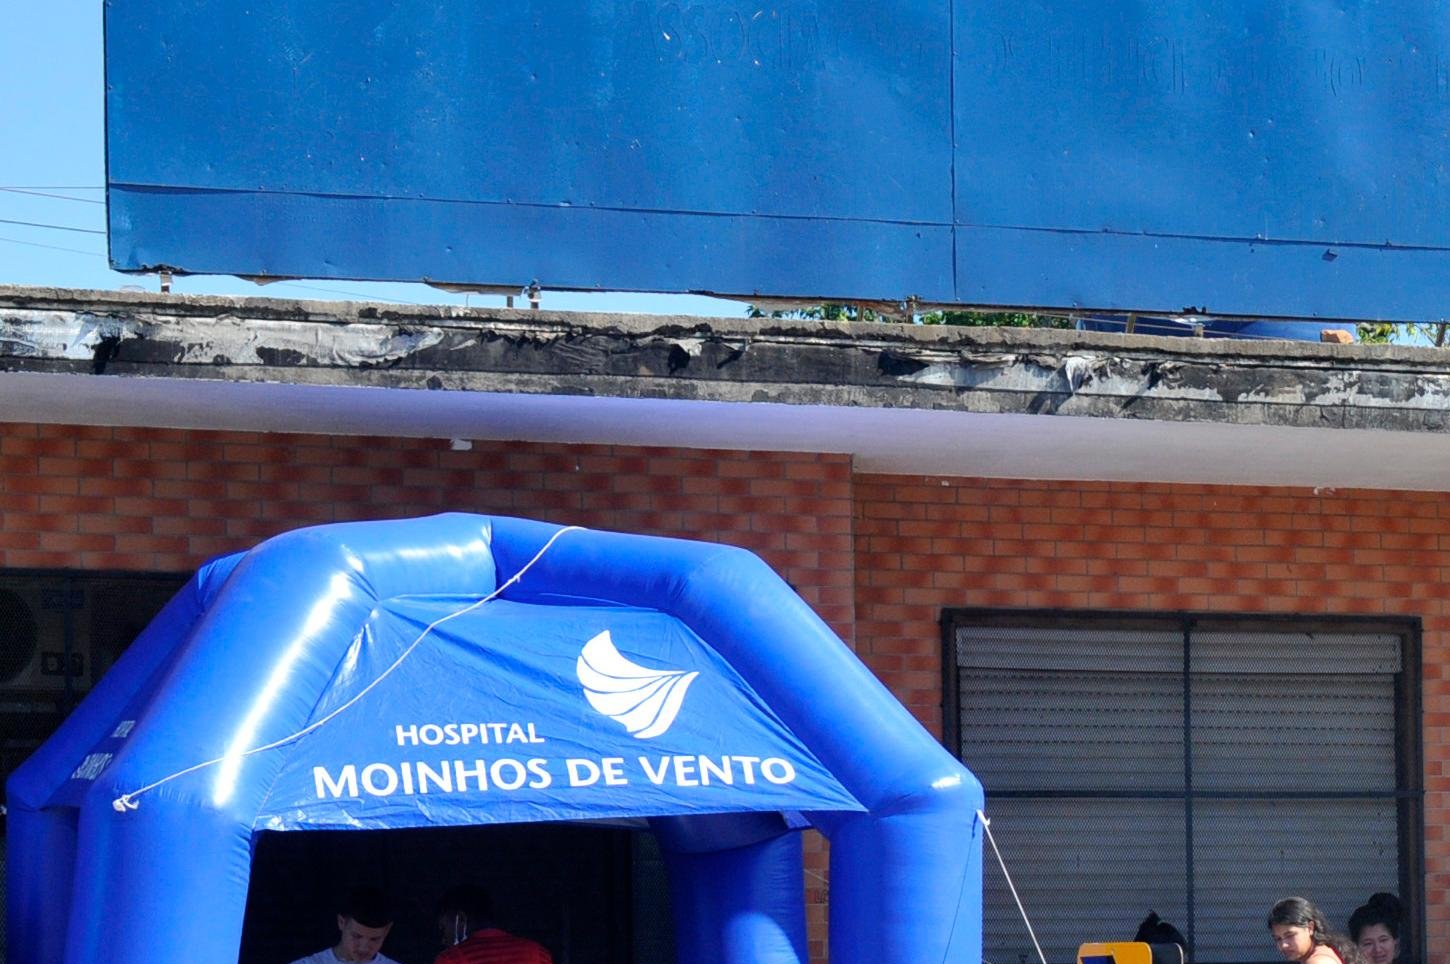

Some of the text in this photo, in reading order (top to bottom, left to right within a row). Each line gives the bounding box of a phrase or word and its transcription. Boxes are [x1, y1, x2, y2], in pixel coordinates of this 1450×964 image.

[395, 722, 545, 746] HOSPITAL
[312, 755, 797, 799] MOINHOS DE VENTO
